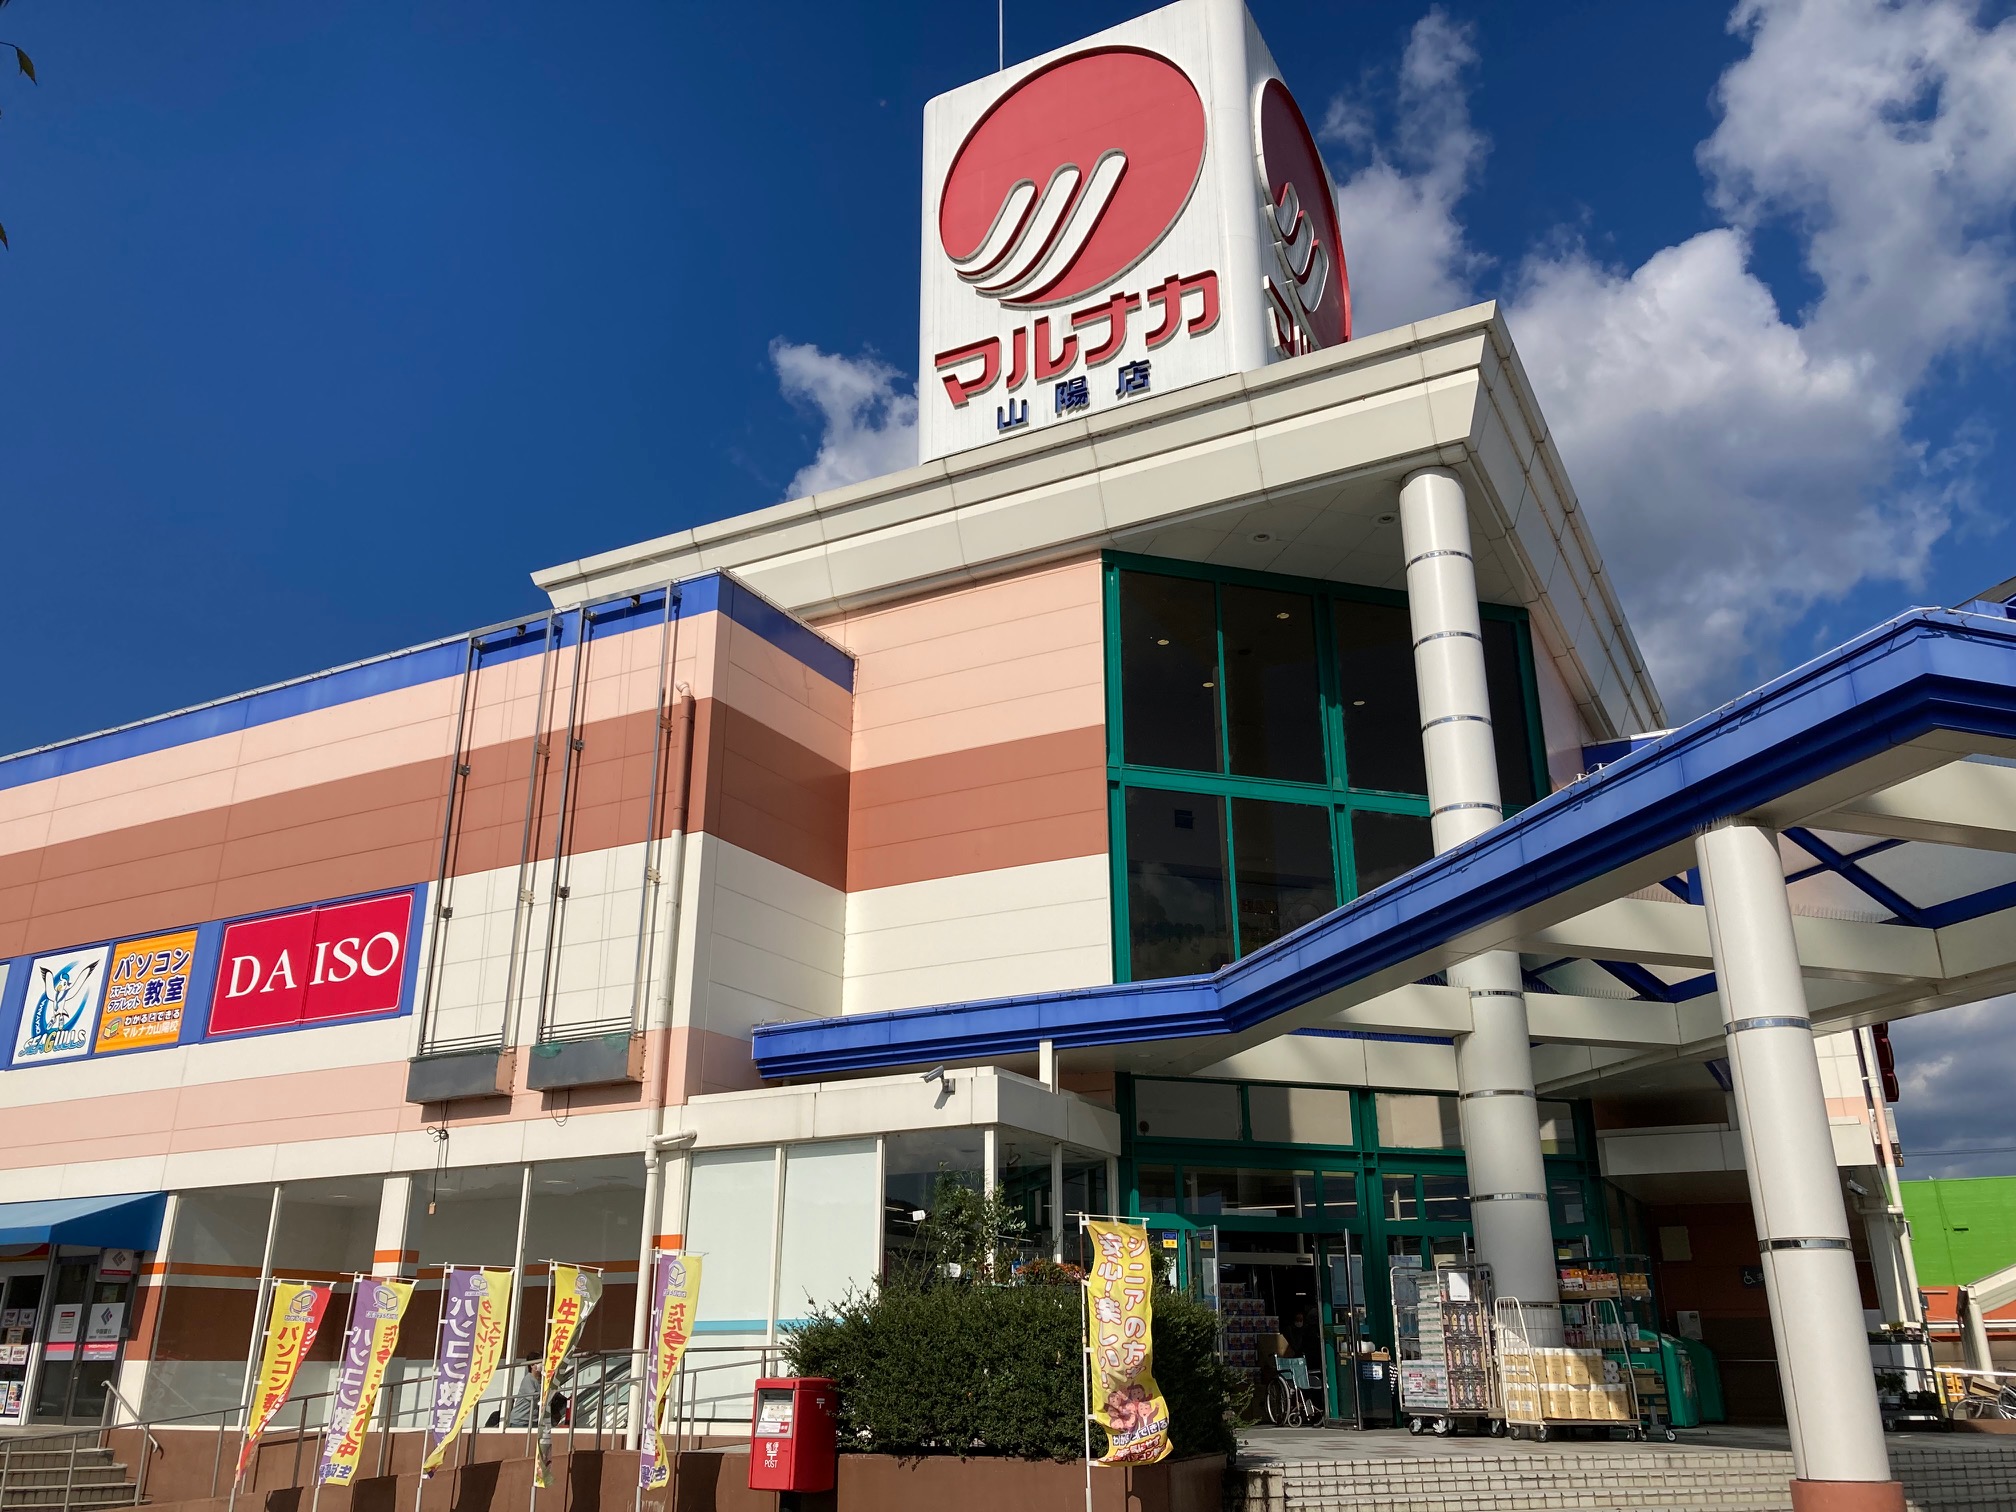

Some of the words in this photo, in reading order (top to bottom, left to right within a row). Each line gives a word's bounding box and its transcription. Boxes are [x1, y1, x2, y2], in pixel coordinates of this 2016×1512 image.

[935, 269, 1221, 409] マルナカ
[997, 359, 1151, 431] 山陽店
[113, 948, 191, 982] パソコン
[225, 931, 400, 998] DAISO
[110, 982, 143, 998] スマートフォン
[143, 975, 186, 1007] 教室
[35, 999, 47, 1034] OKAYAMA
[107, 998, 140, 1013] タブレット
[124, 1009, 180, 1026] わかるとできる
[23, 1029, 87, 1054] SEAGULLS
[766, 1442, 779, 1451] 郵便
[765, 1460, 778, 1468] POST
